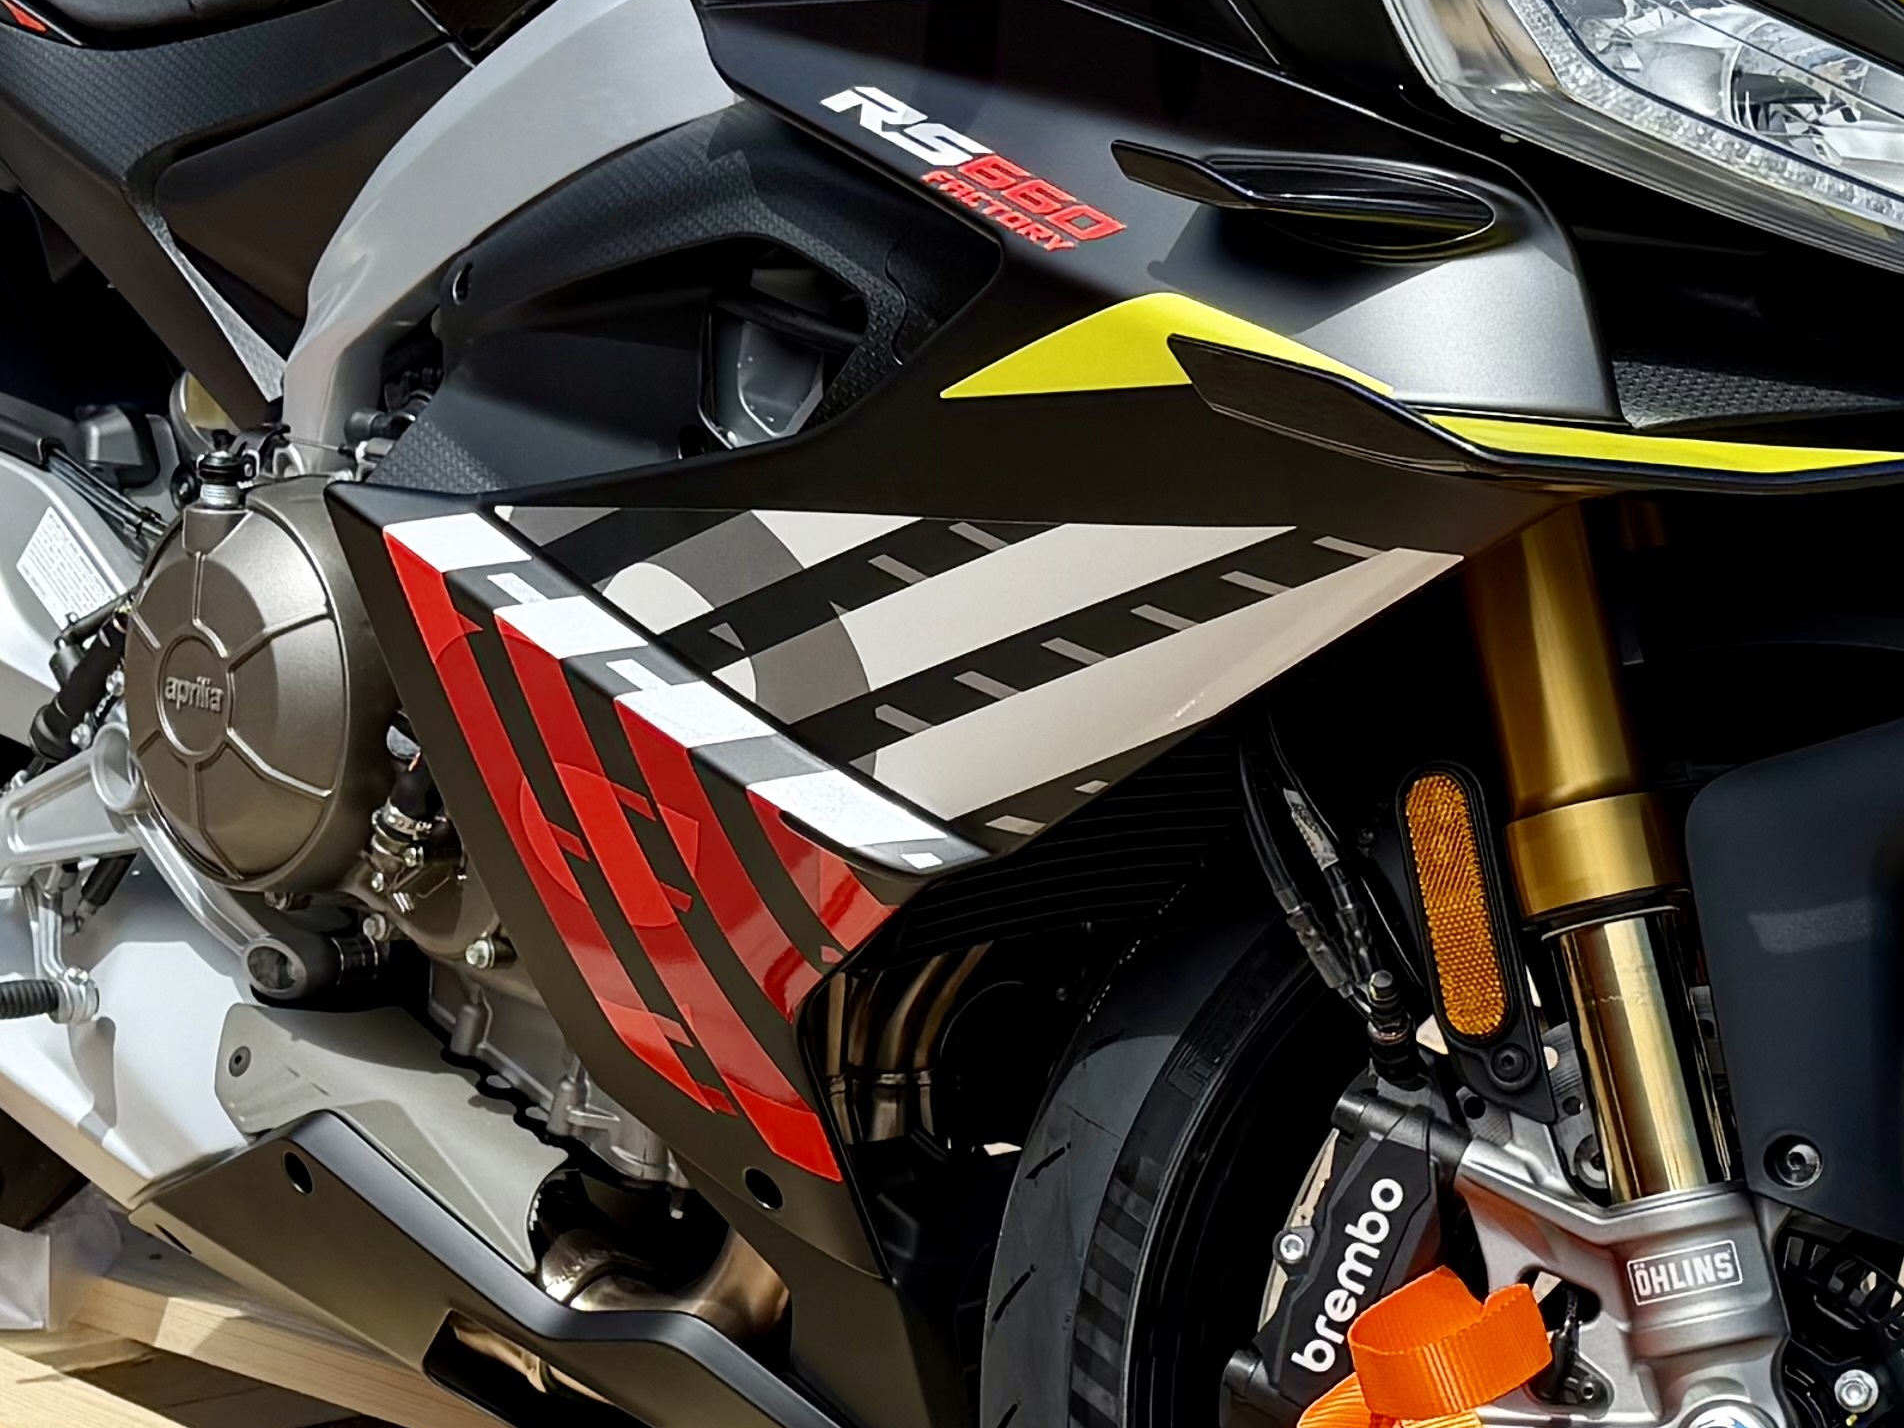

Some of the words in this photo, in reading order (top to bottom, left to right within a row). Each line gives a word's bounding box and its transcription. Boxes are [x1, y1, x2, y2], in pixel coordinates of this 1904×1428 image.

[921, 169, 1079, 252] FACTORY
[164, 675, 225, 715] aprilia
[1290, 1177, 1403, 1373] brembo
[1634, 1252, 1734, 1296] ÖHLINS
